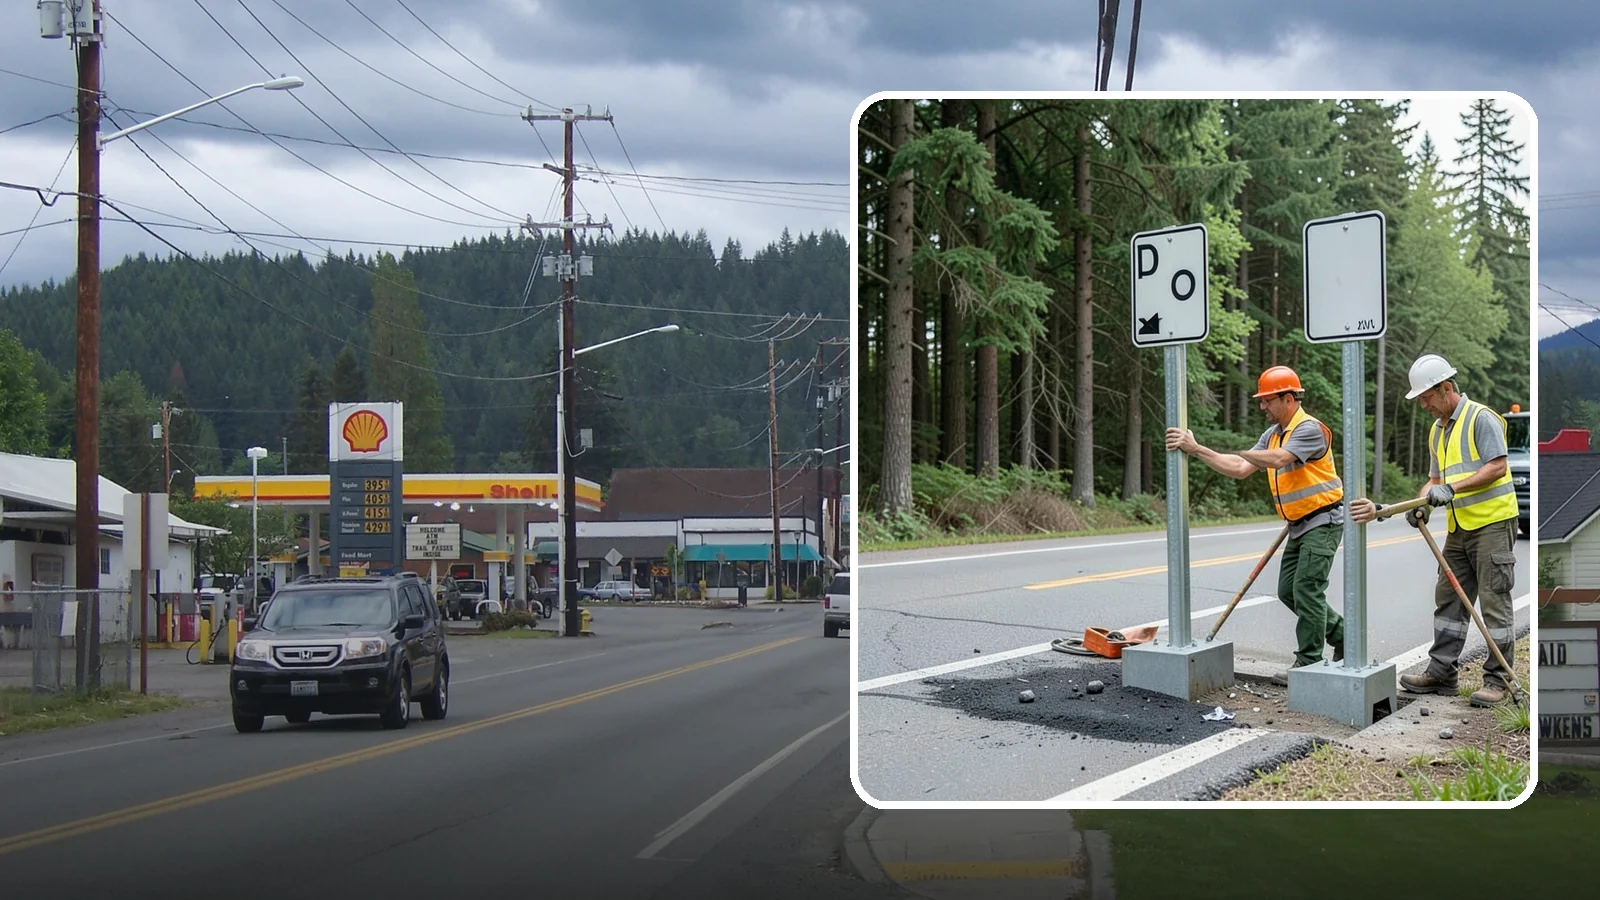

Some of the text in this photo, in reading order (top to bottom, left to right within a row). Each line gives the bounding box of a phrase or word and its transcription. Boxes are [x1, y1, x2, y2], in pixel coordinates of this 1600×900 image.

[1171, 269, 1196, 301] O
[366, 480, 384, 490] 395
[490, 484, 547, 498] Shell
[366, 494, 384, 504] 405
[366, 508, 384, 518] 415
[366, 522, 384, 532] 429
